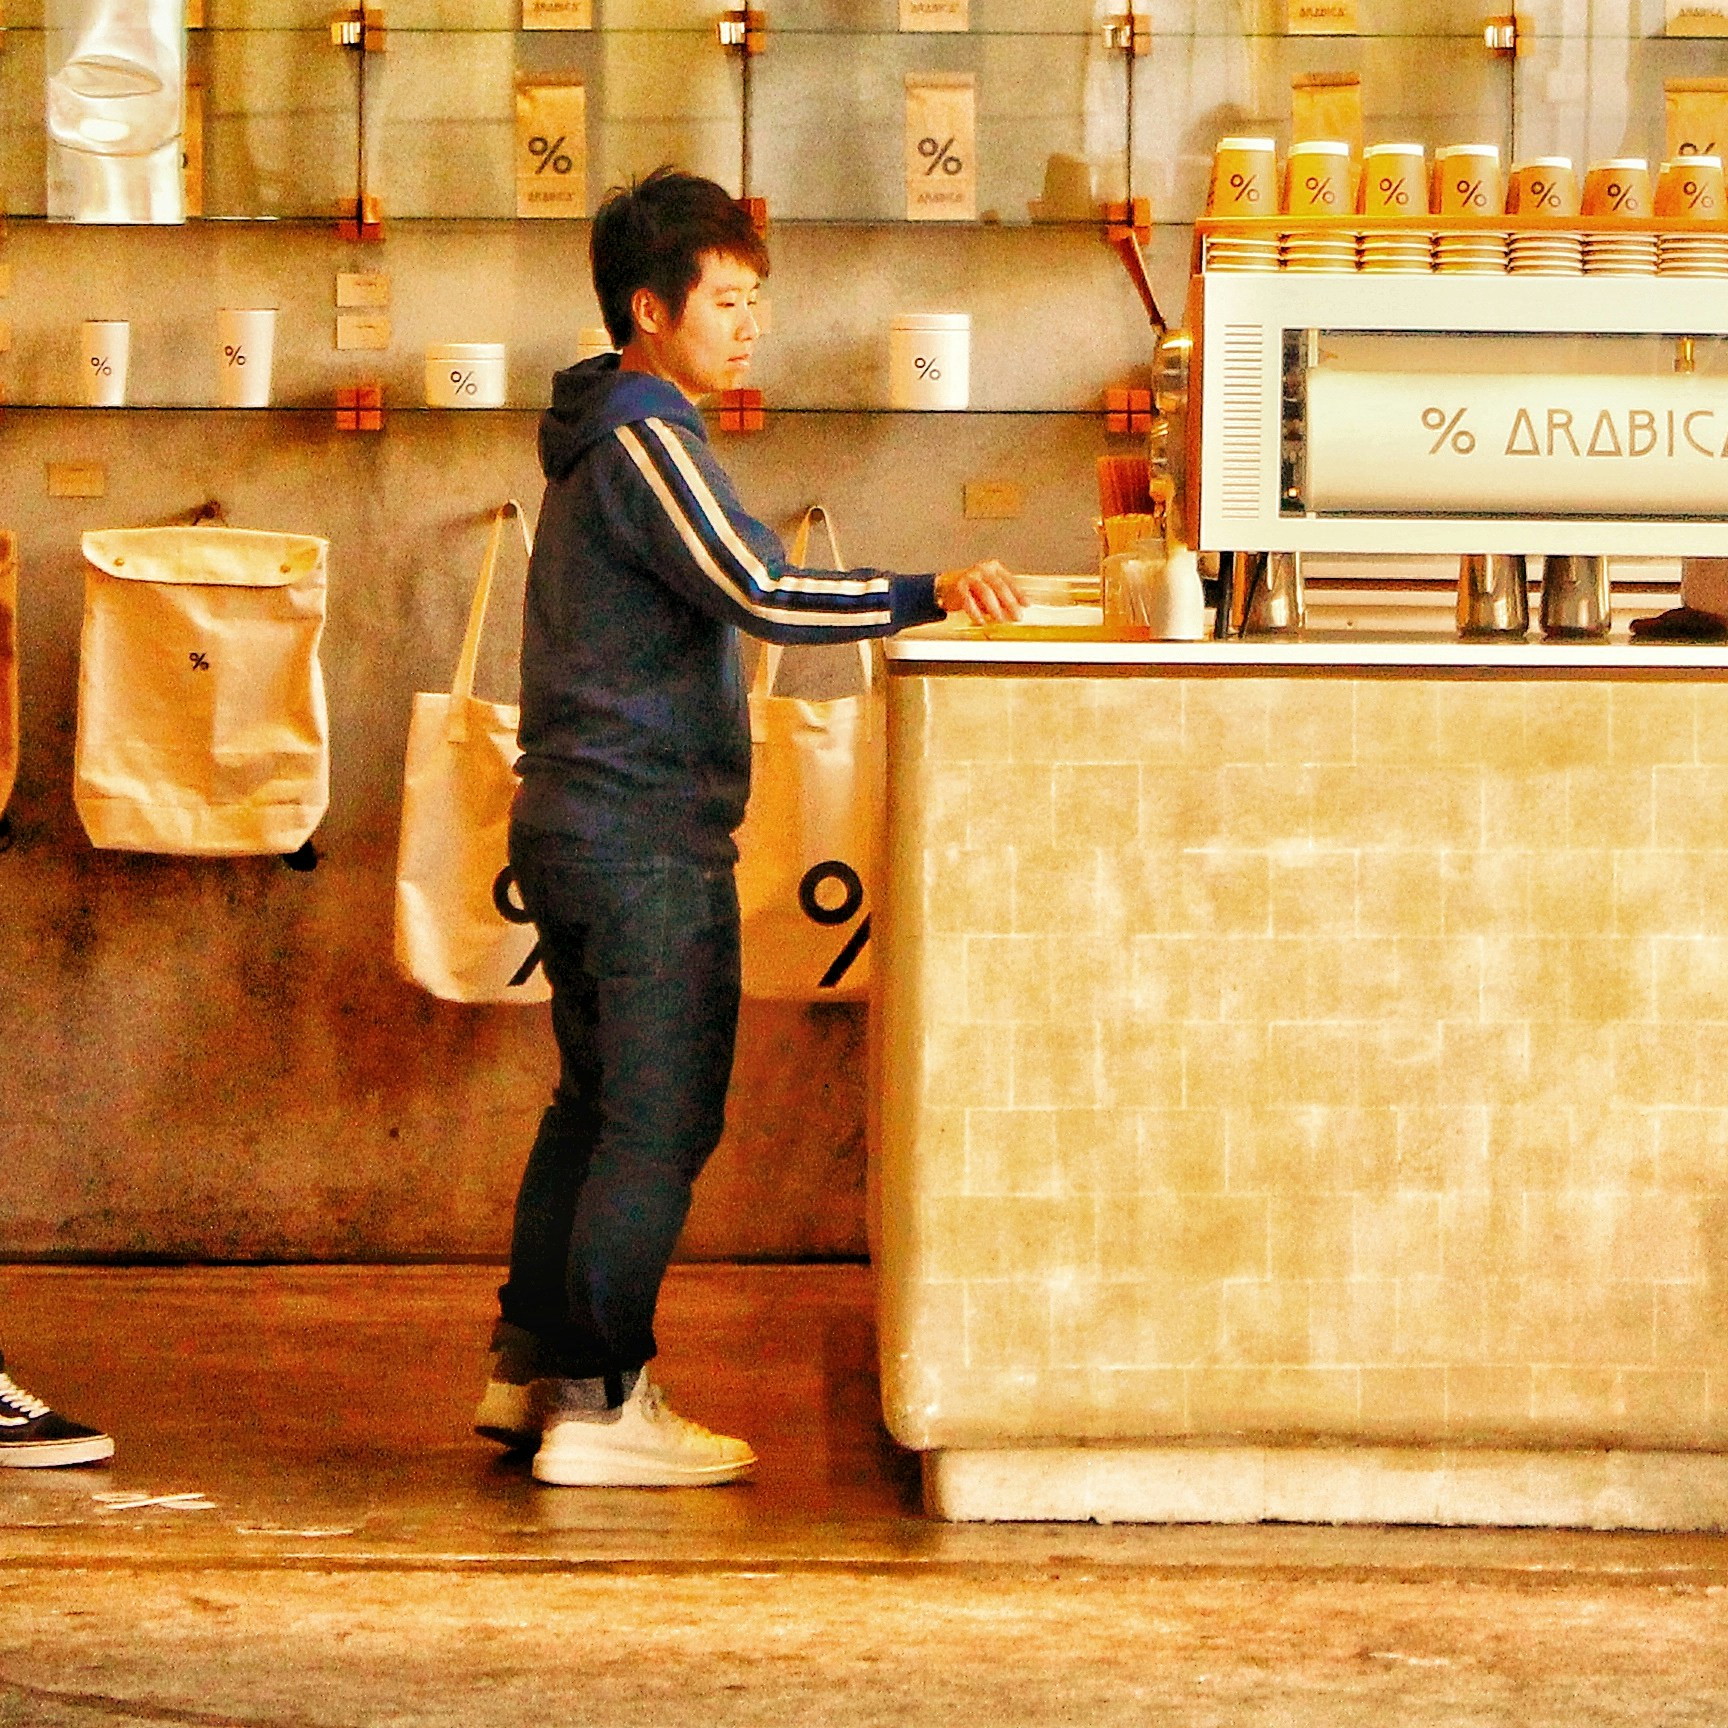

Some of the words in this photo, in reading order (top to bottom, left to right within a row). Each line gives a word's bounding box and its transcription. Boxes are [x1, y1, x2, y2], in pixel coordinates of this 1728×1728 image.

[528, 135, 573, 175] %
[917, 137, 963, 176] %
[1421, 406, 1476, 456] %
